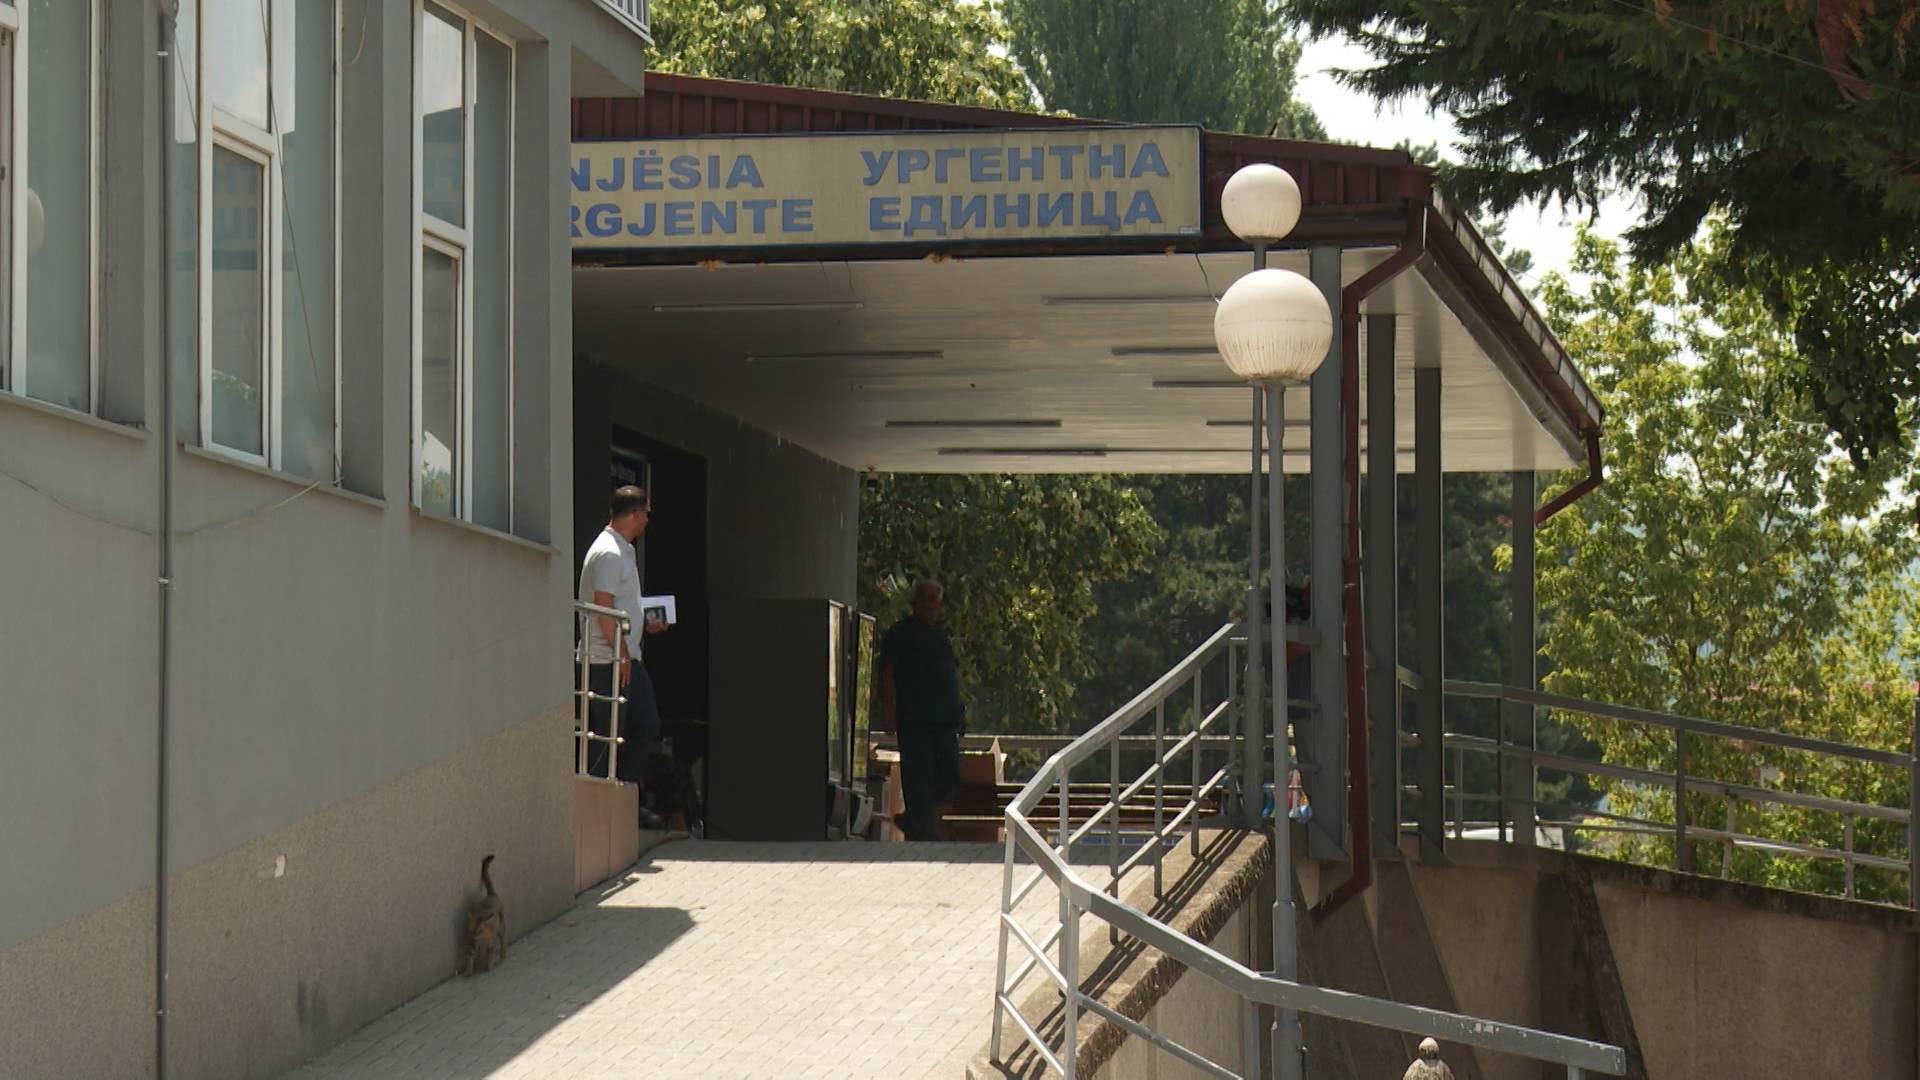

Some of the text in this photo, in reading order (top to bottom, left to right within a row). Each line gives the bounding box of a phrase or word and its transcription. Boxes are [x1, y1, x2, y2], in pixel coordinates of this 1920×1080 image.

[860, 143, 1169, 185] УРГЕНТНА
[571, 199, 813, 239] GJENTE
[868, 191, 1163, 237] ЕДИНИЦА
